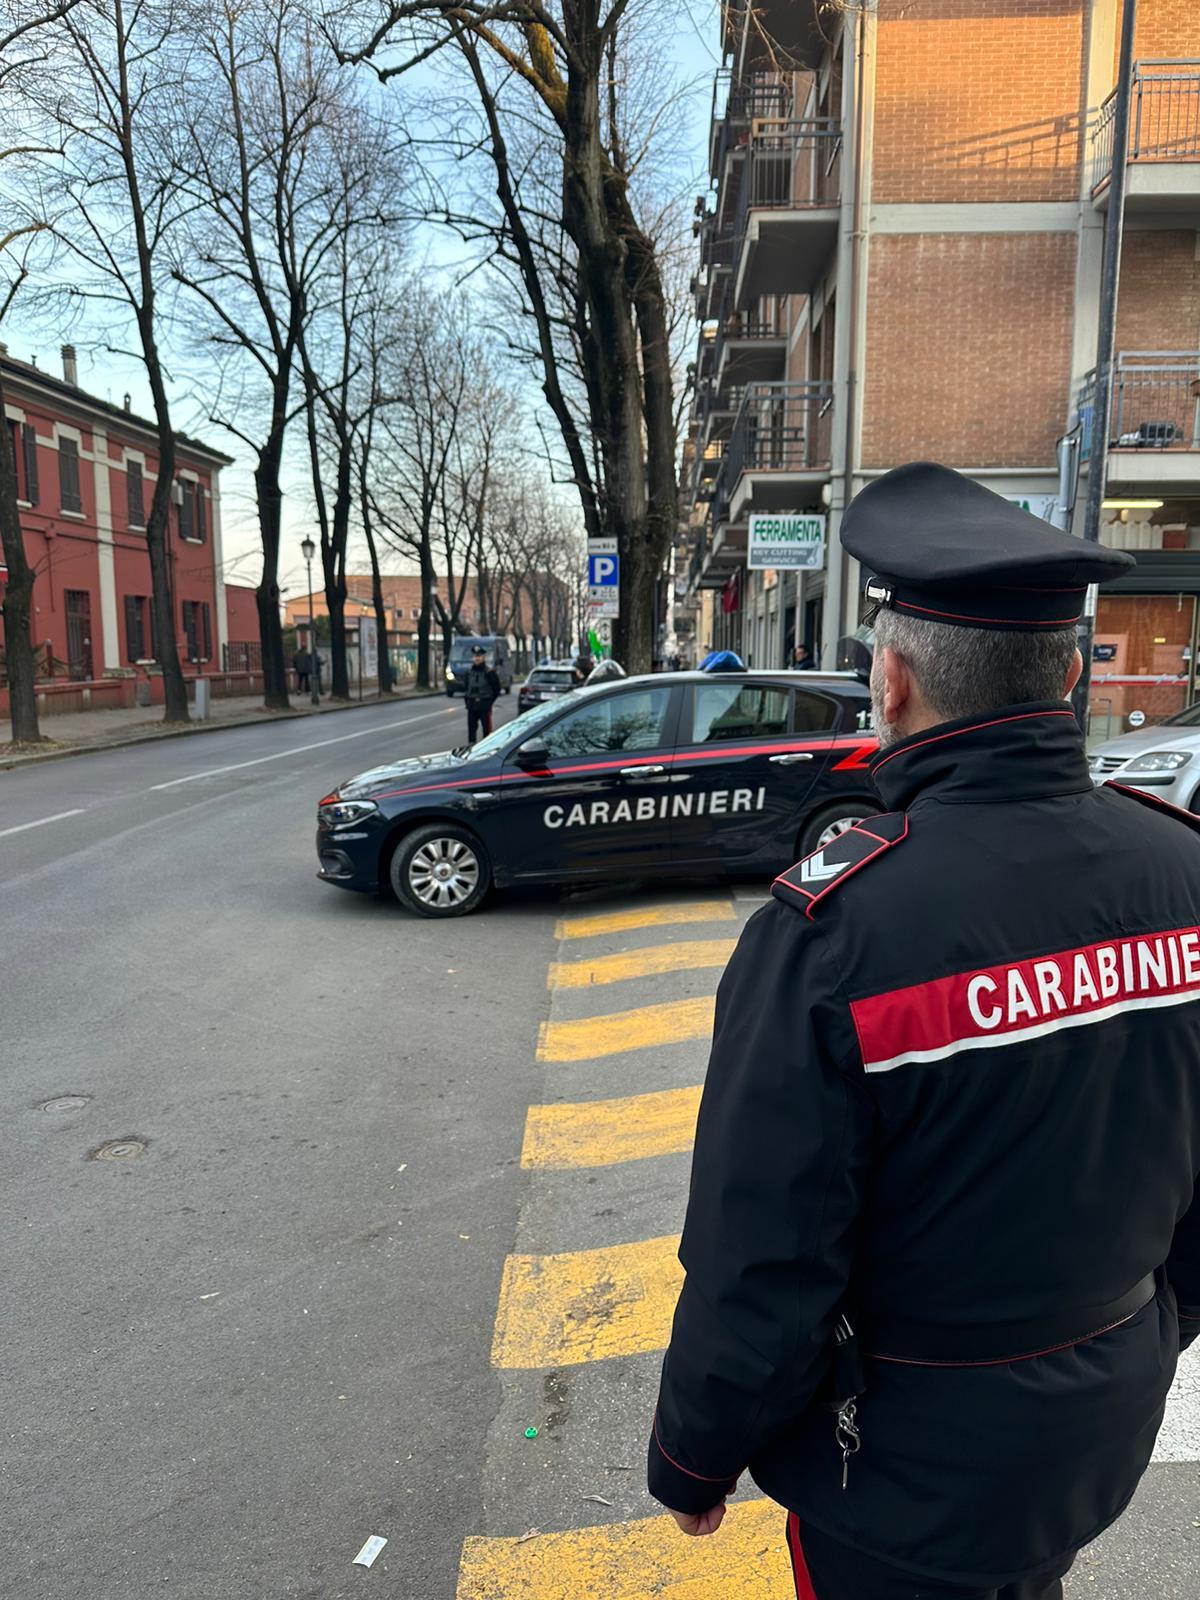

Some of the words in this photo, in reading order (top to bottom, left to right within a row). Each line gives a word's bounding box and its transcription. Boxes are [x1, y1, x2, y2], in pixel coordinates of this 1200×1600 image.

[754, 520, 821, 541] FERRAMENTA
[594, 557, 614, 583] P
[543, 787, 766, 828] CARABINIERI
[967, 932, 1200, 1030] CARABINIE
